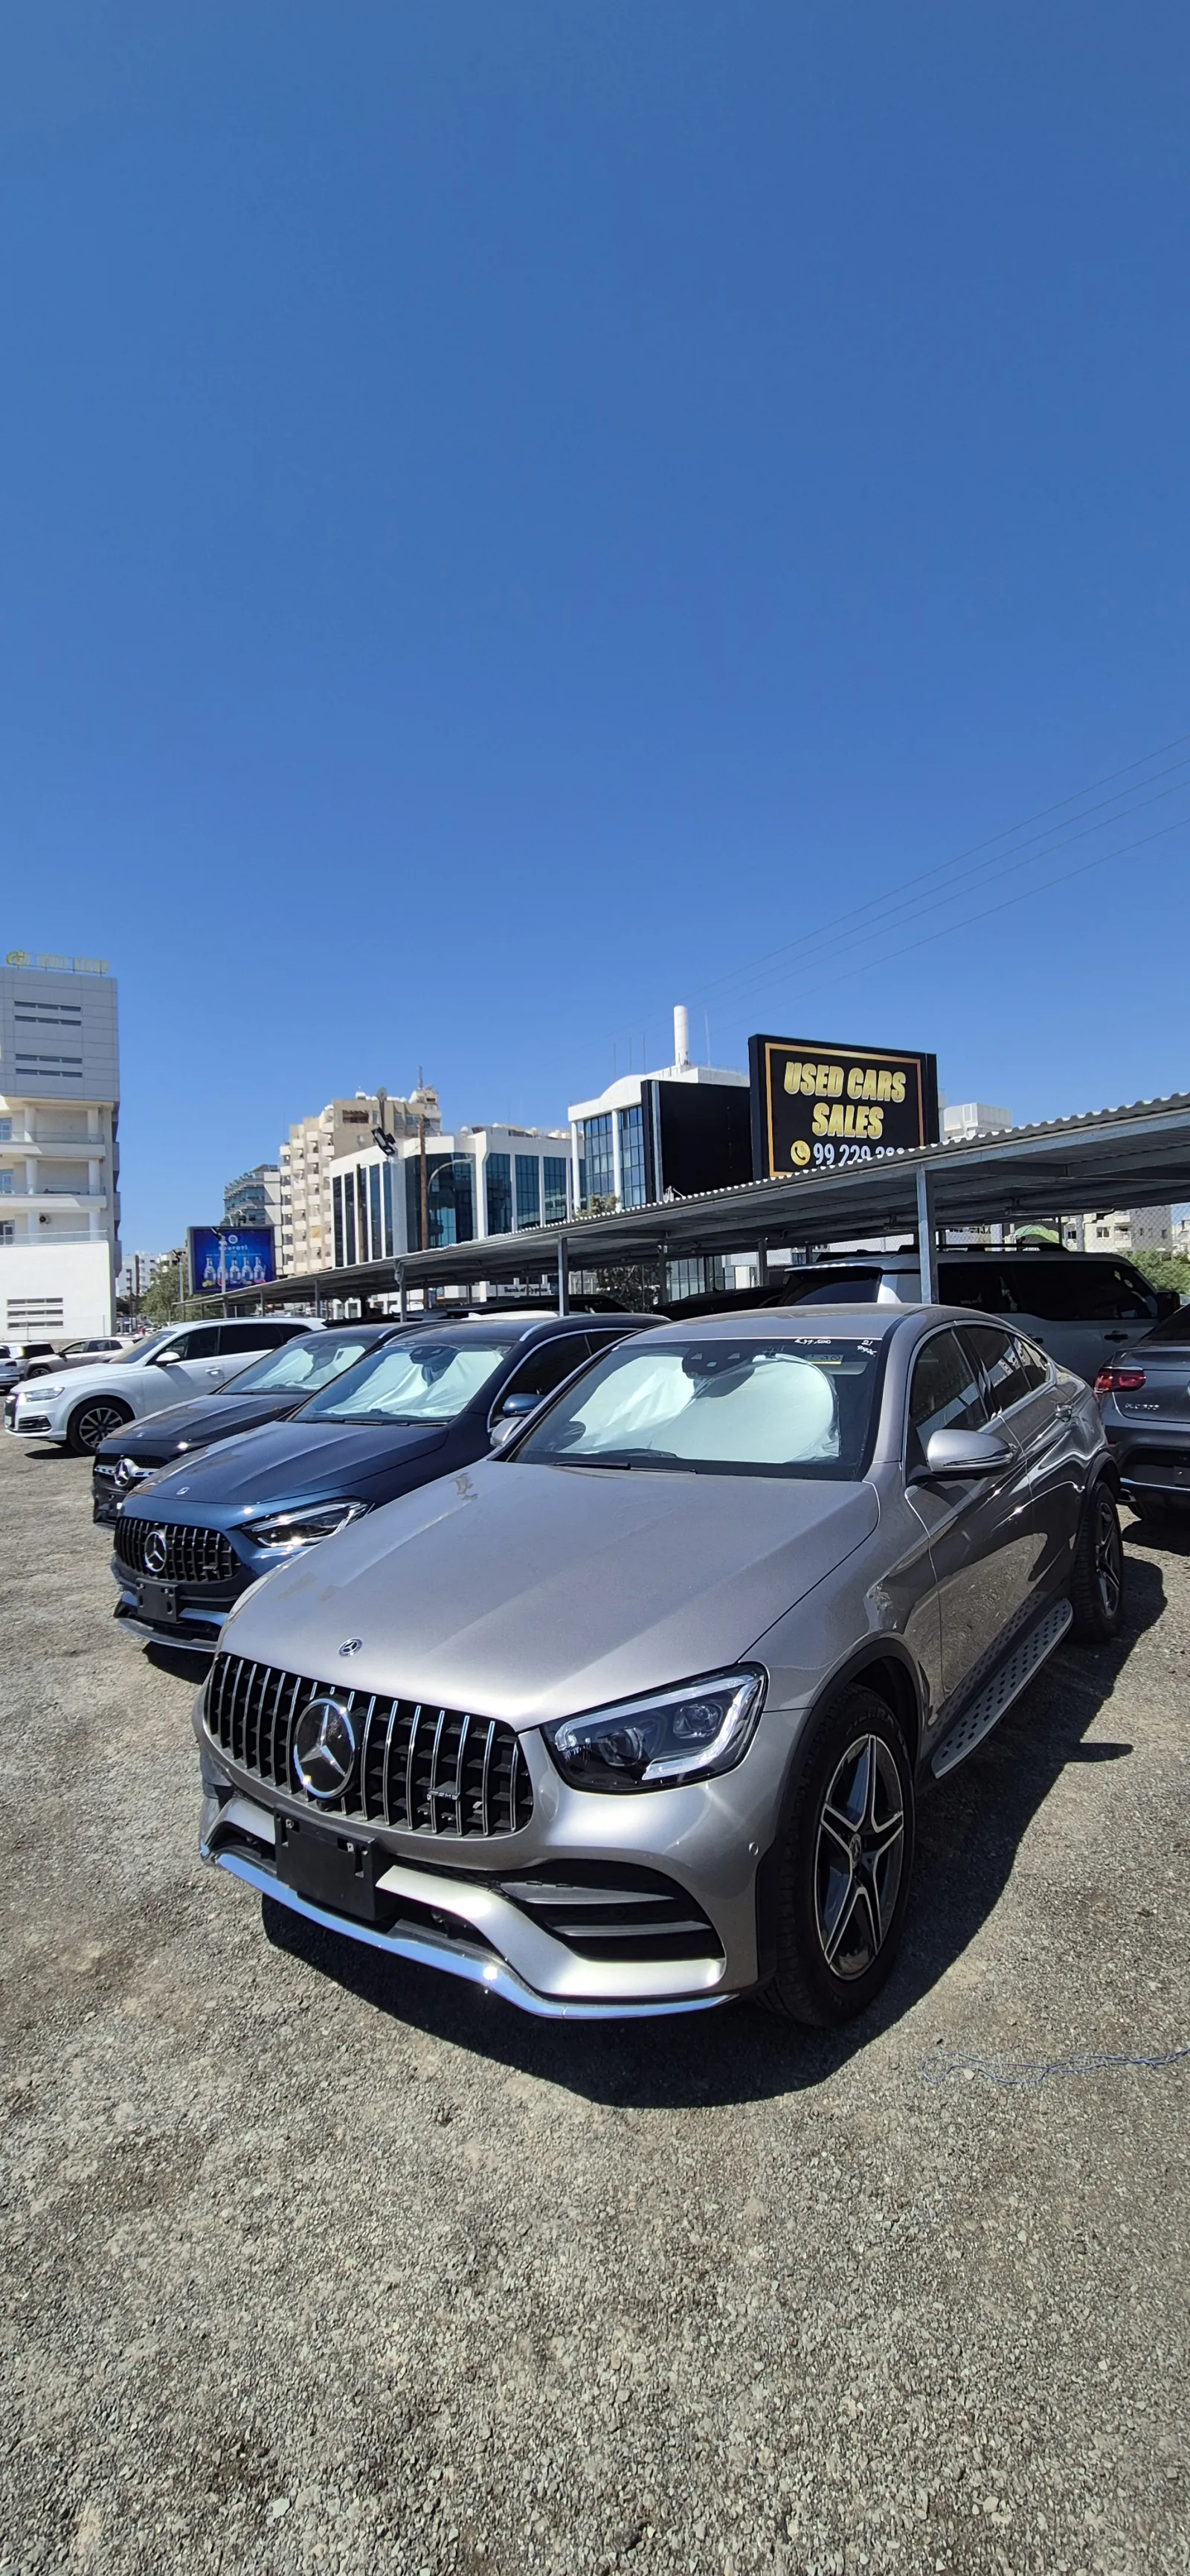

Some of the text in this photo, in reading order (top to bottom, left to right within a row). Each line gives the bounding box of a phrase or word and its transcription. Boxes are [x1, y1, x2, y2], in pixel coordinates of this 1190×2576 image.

[784, 1061, 907, 1103] USED CARS
[812, 1102, 884, 1140] SALES
[813, 1143, 835, 1166] 99
